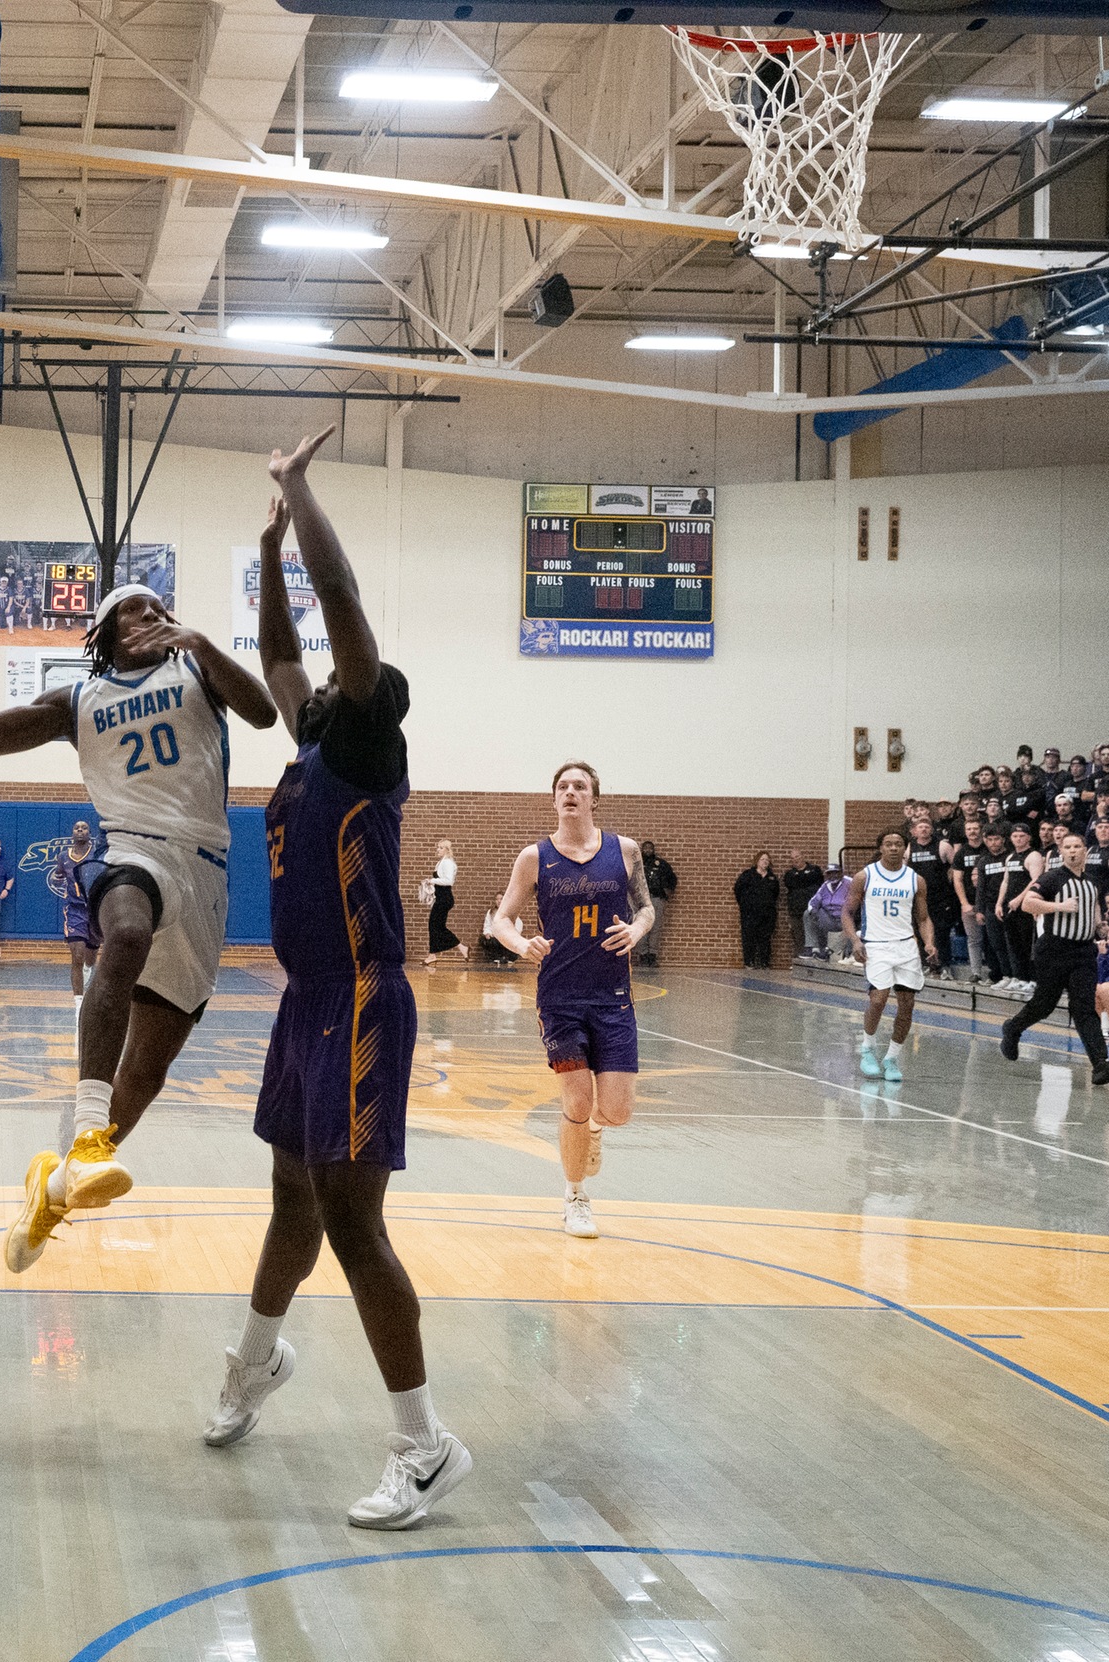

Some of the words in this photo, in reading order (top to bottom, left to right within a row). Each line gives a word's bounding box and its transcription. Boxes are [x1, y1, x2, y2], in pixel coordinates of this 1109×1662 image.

[530, 519, 570, 531] HOME
[668, 522, 711, 534] VISITOR
[543, 560, 572, 570] BONUS
[596, 562, 624, 571] PERIOD
[667, 563, 696, 573] BONUS
[536, 576, 563, 586] FOULS
[590, 577, 622, 587] PLAYER
[628, 577, 655, 588] FOULS
[675, 578, 702, 589] FOULS
[53, 583, 86, 610] 26
[560, 629, 628, 647] ROCKAR!
[633, 631, 711, 649] STOCKAR!
[93, 685, 184, 735] BETHANY
[120, 722, 181, 777] 20
[549, 875, 620, 899] Wesleyan
[871, 887, 910, 899] BETHANY
[882, 900, 900, 917] 15
[573, 904, 599, 938] 14
